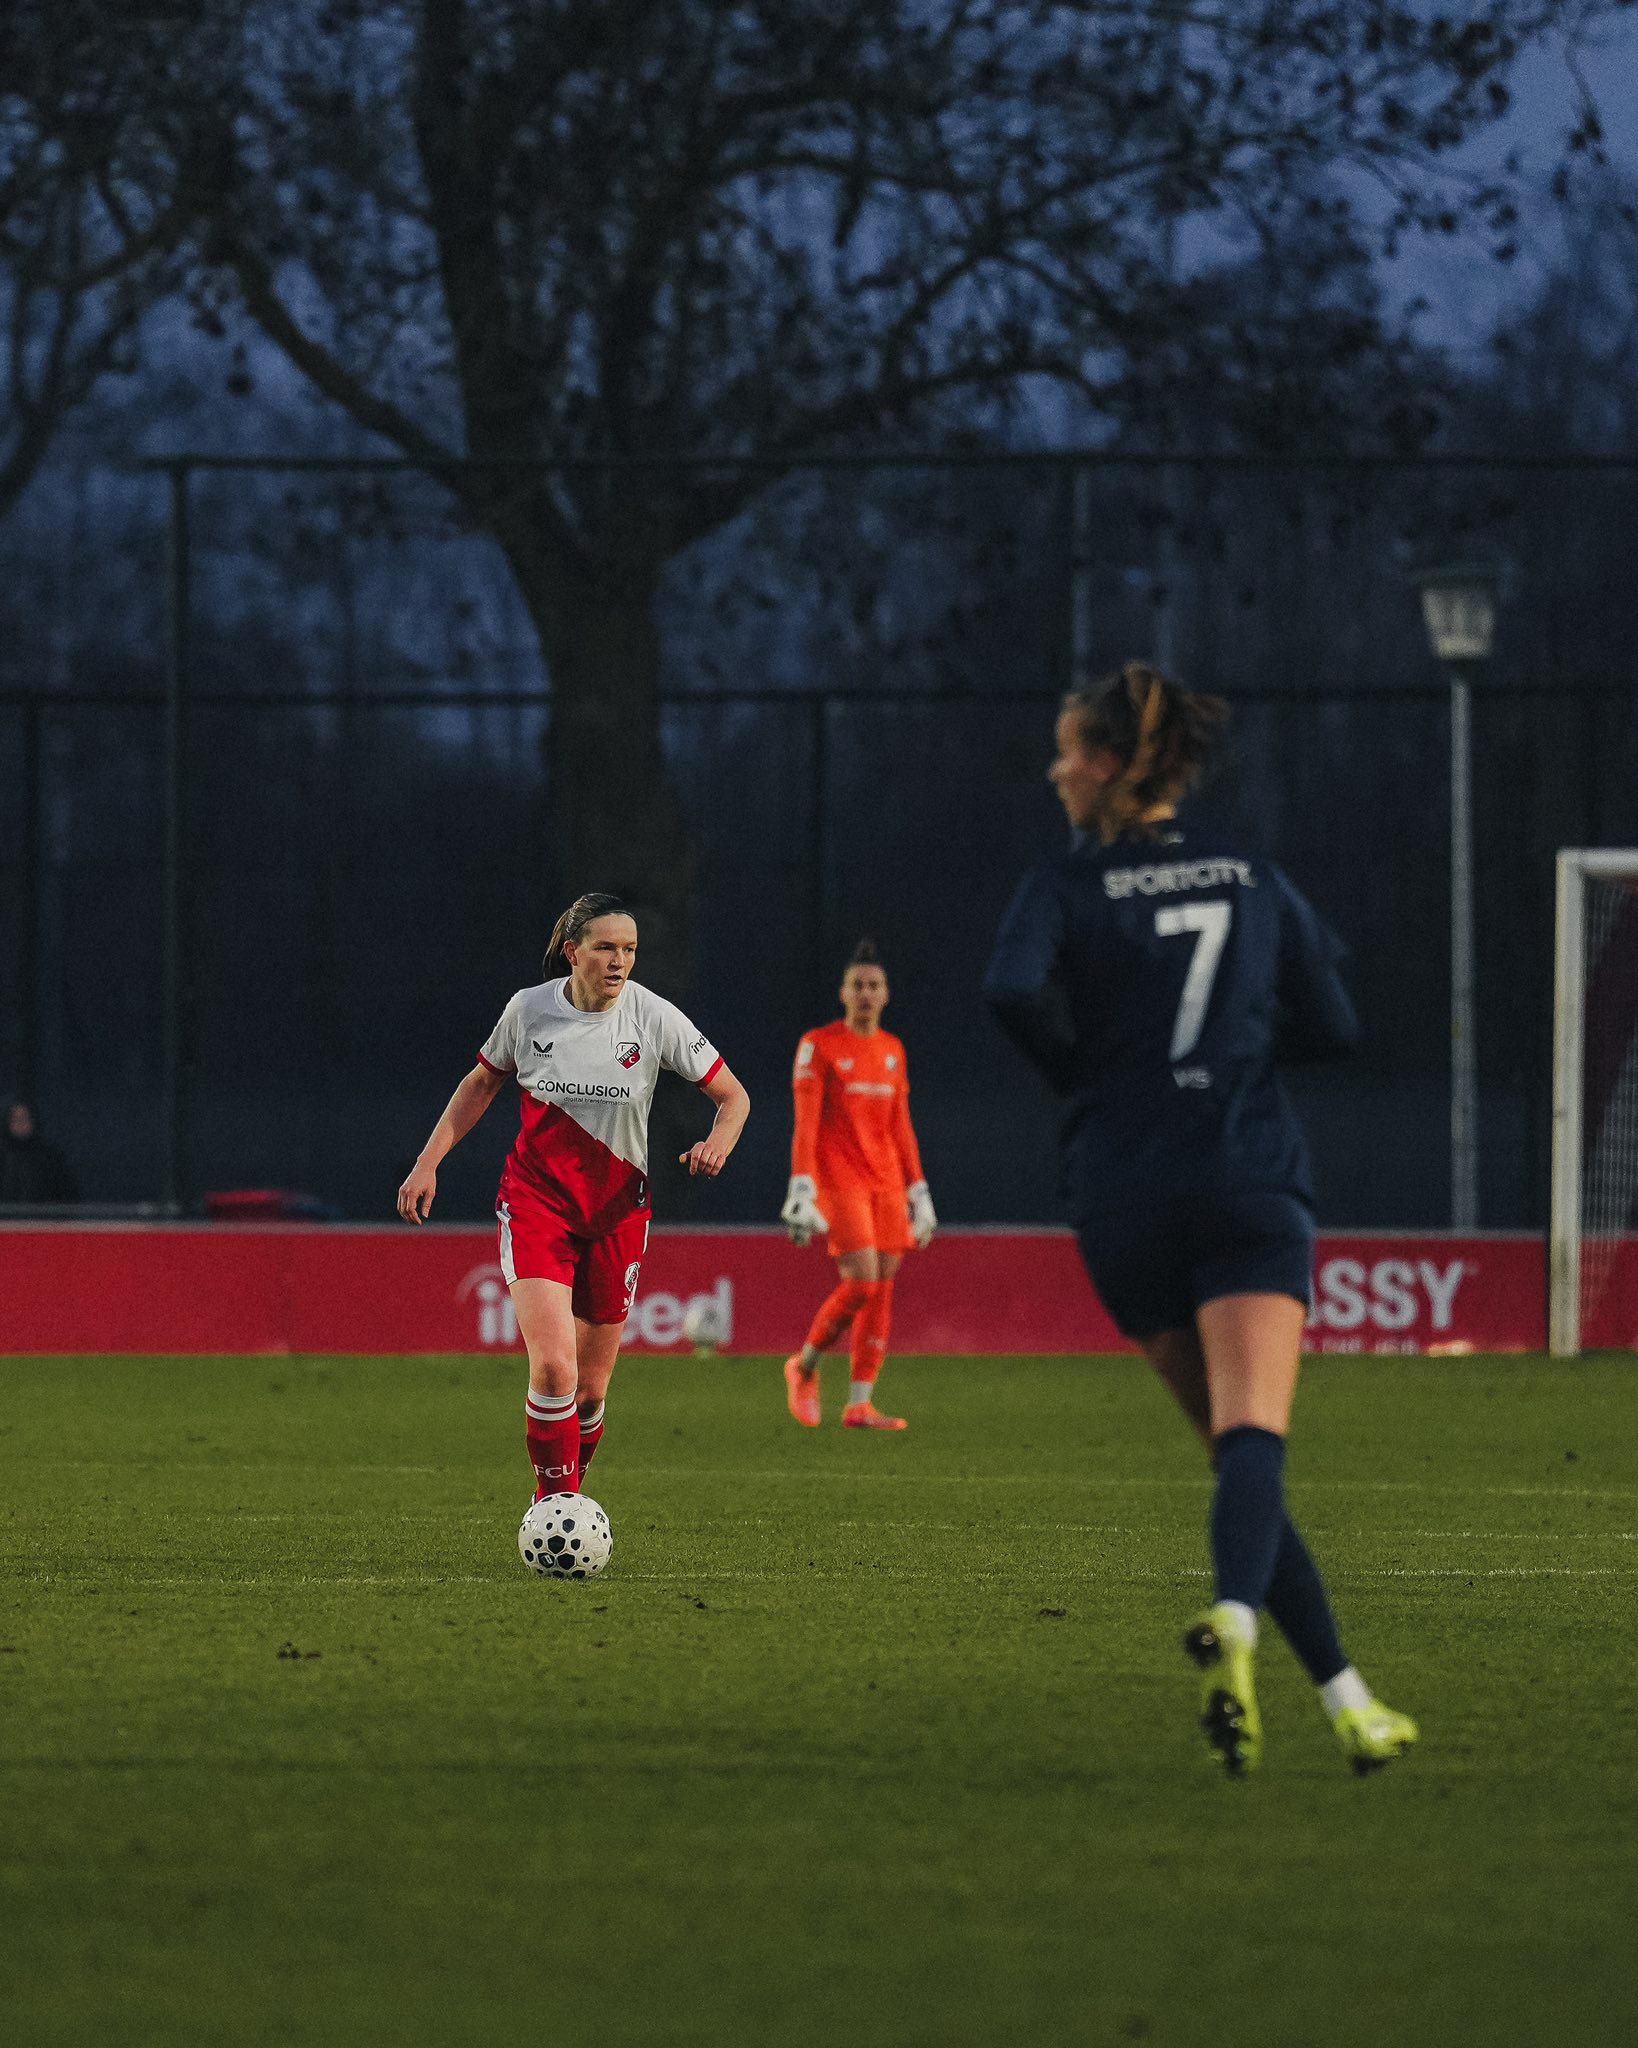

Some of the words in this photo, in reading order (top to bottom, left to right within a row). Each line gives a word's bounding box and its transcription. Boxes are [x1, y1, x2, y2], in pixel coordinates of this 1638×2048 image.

[1103, 857, 1254, 899] SPORTCITY
[1154, 900, 1231, 1062] 7
[537, 1079, 631, 1099] CONCLUSION
[1306, 1258, 1464, 1331] SSY
[533, 1460, 576, 1479] FCU
